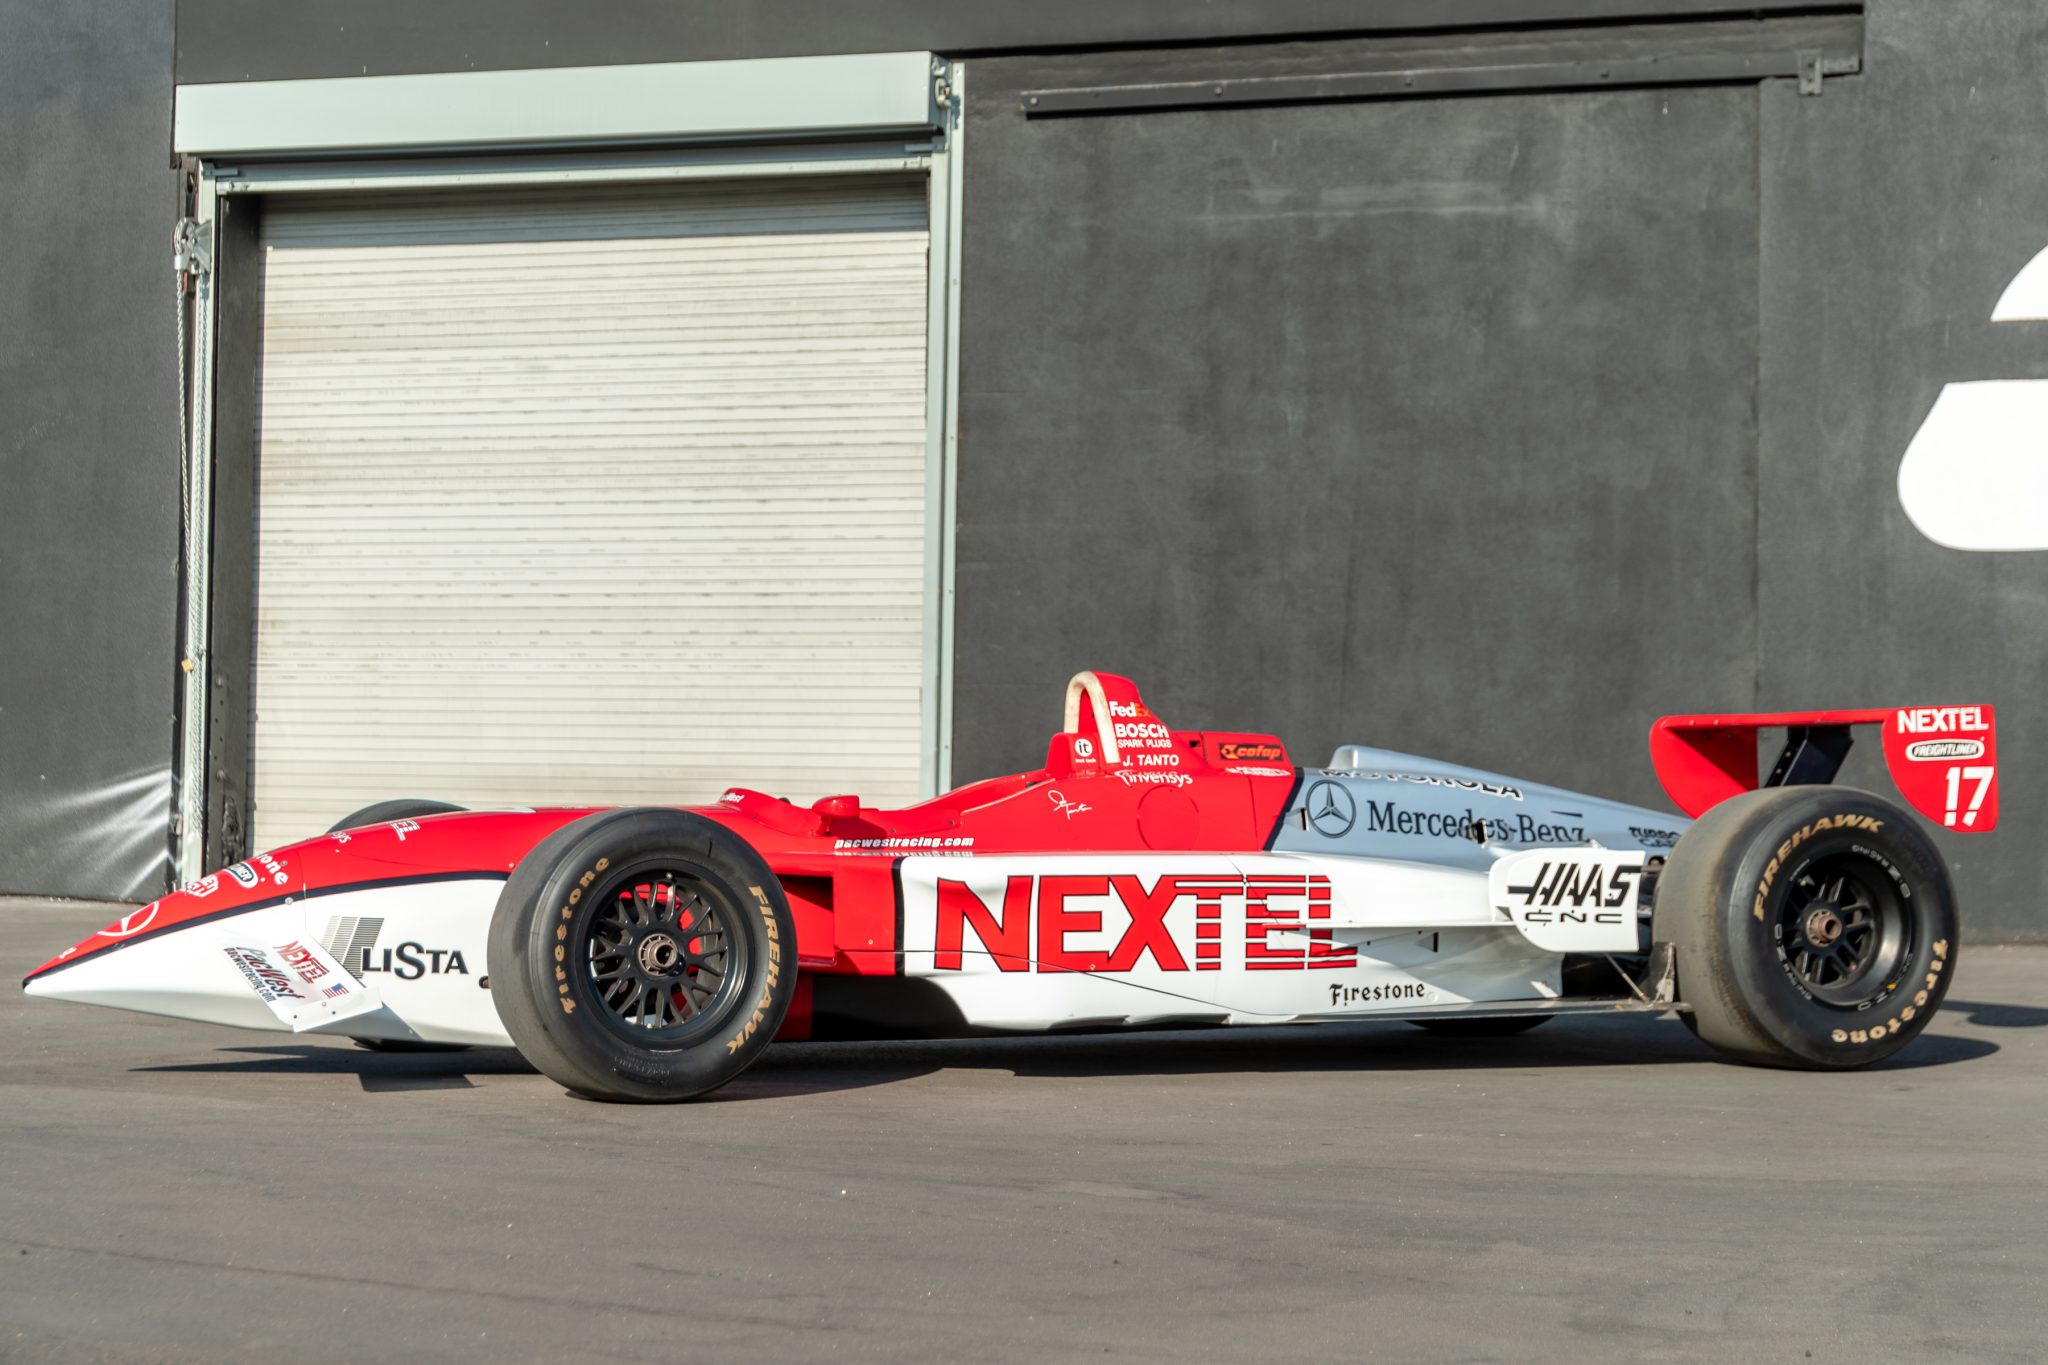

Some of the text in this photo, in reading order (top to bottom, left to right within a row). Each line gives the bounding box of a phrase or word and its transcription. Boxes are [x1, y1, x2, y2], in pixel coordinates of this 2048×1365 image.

[1115, 724, 1169, 738] BOSCH
[1897, 707, 1989, 733] NEXTEL
[1078, 742, 1090, 754] it
[1117, 739, 1172, 749] SPARK PLUGS
[1122, 755, 1179, 767] J. TANTO
[1237, 743, 1281, 760] cofap
[1913, 743, 1979, 757] FREIGHTLINER
[1124, 770, 1193, 788] invensys
[1944, 766, 1994, 827] 17
[1367, 800, 1589, 844] Mercedes-Benz
[834, 837, 974, 850] pacwestracing.com
[1508, 862, 1642, 907] HAAS
[1754, 814, 1885, 922] FIREHAWK
[554, 857, 609, 1014] Firestone
[934, 874, 1358, 974] NEXTEL
[234, 946, 306, 1000] PacWest
[272, 940, 330, 985] NEXTEL
[726, 885, 780, 1055] FIREHAWK
[1329, 981, 1426, 1007] Firestone
[1833, 938, 1948, 1043] Firestone
